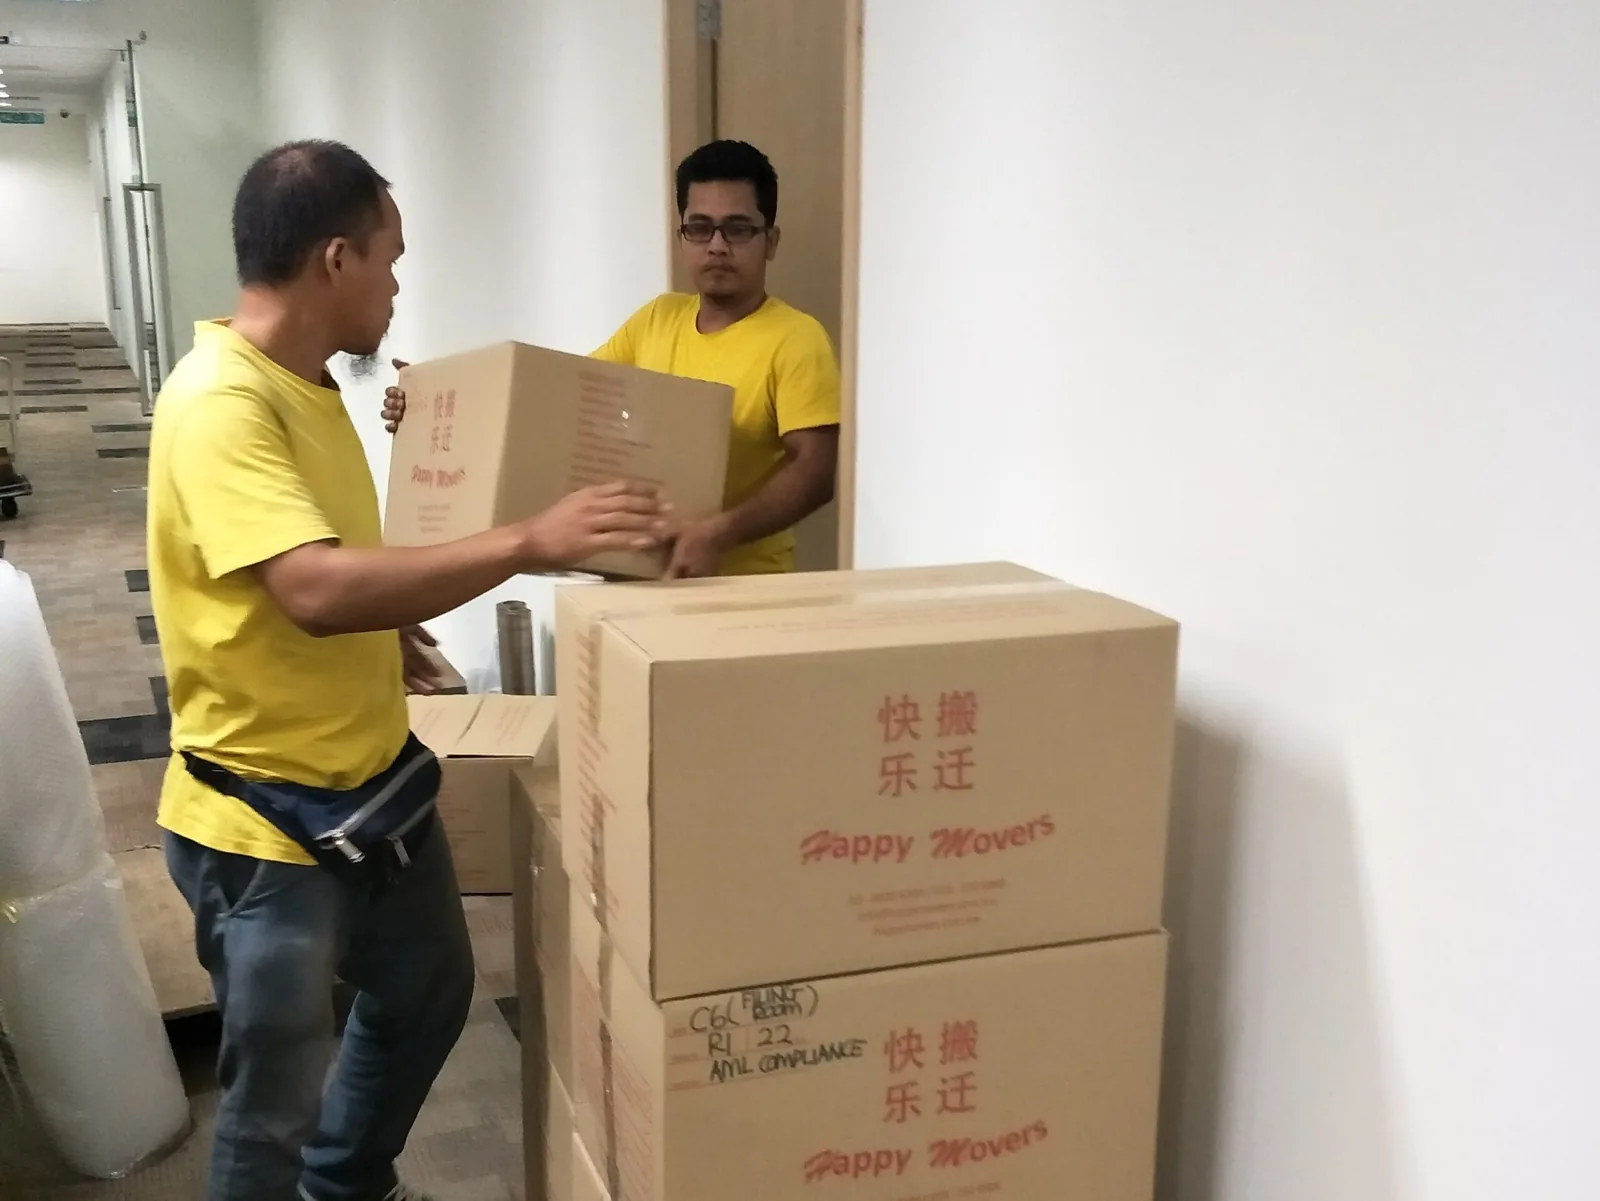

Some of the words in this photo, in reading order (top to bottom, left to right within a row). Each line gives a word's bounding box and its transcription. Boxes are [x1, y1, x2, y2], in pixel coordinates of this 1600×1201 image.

[800, 829, 914, 865] Happy
[930, 813, 1056, 859] Movers
[757, 1024, 793, 1046] 22
[710, 1056, 754, 1083] AML
[758, 1038, 868, 1074] COMPLIANCE
[804, 1149, 912, 1184] Happy
[927, 1119, 1049, 1169] Movers
